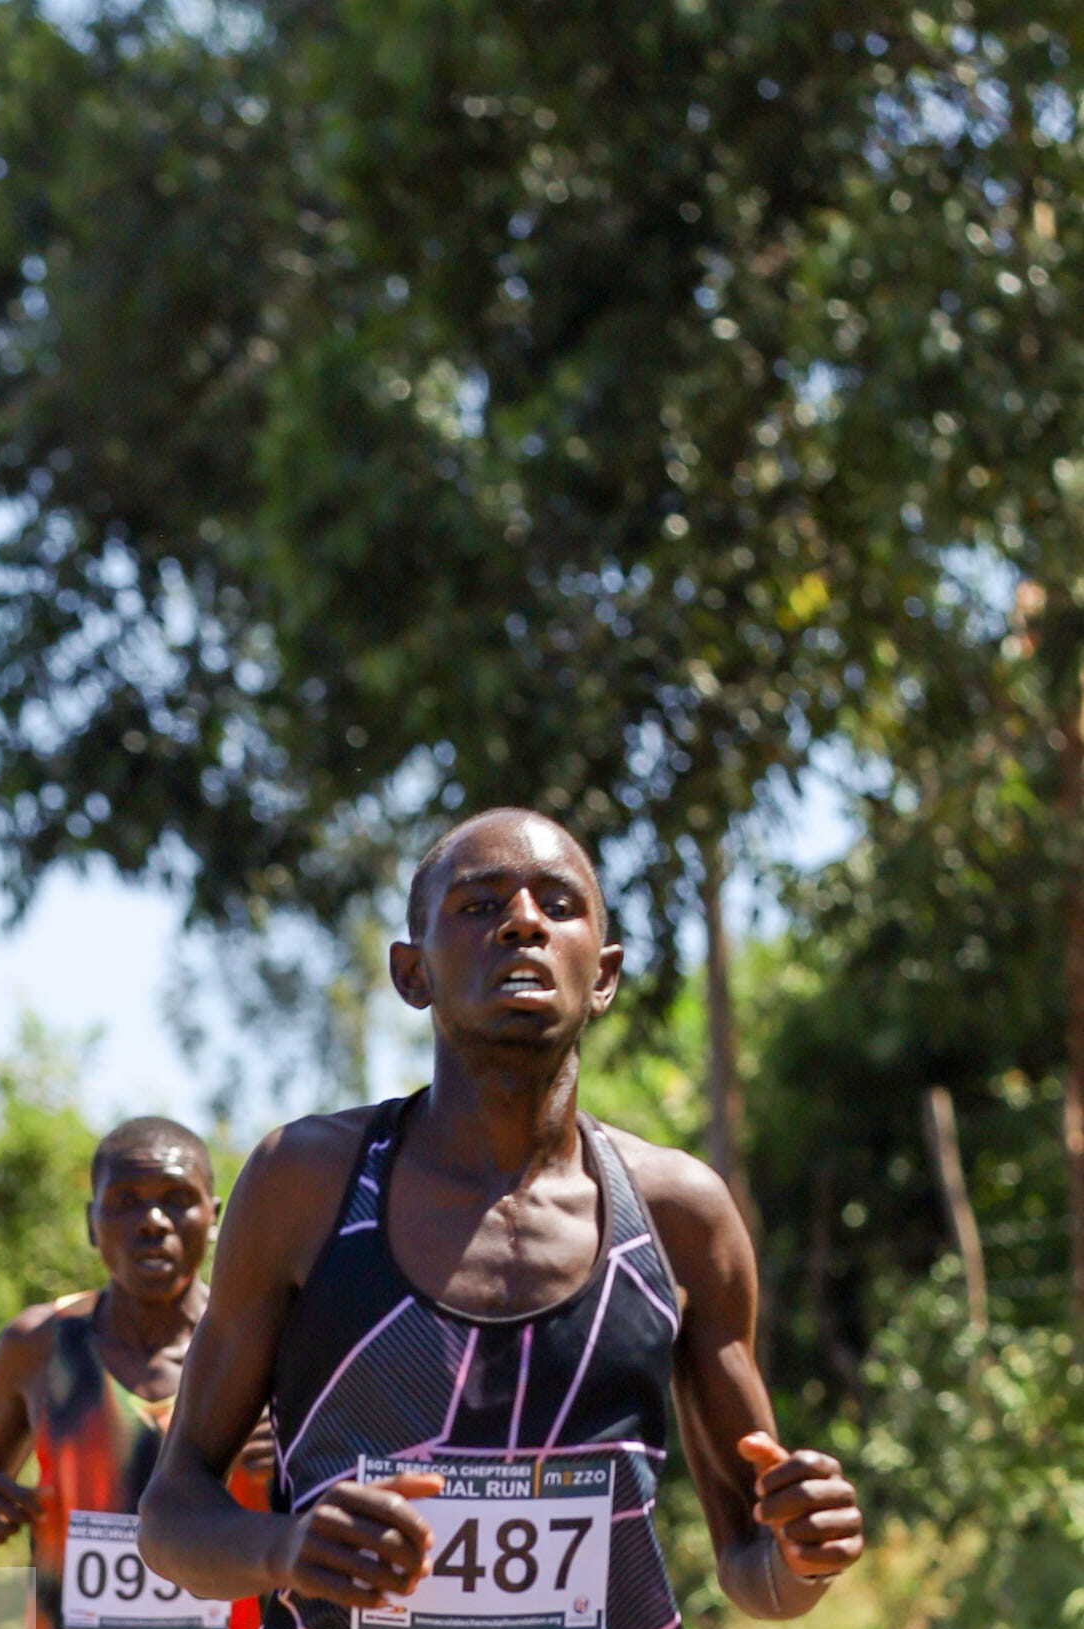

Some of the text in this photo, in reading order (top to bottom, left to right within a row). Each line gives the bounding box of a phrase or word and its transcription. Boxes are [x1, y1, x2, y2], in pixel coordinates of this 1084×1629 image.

[396, 1462, 457, 1475] REBECCA
[459, 1465, 531, 1477] CHEPTEGEI
[485, 1480, 530, 1497] RUN
[432, 1517, 593, 1593] 487
[77, 1550, 181, 1601] 09
